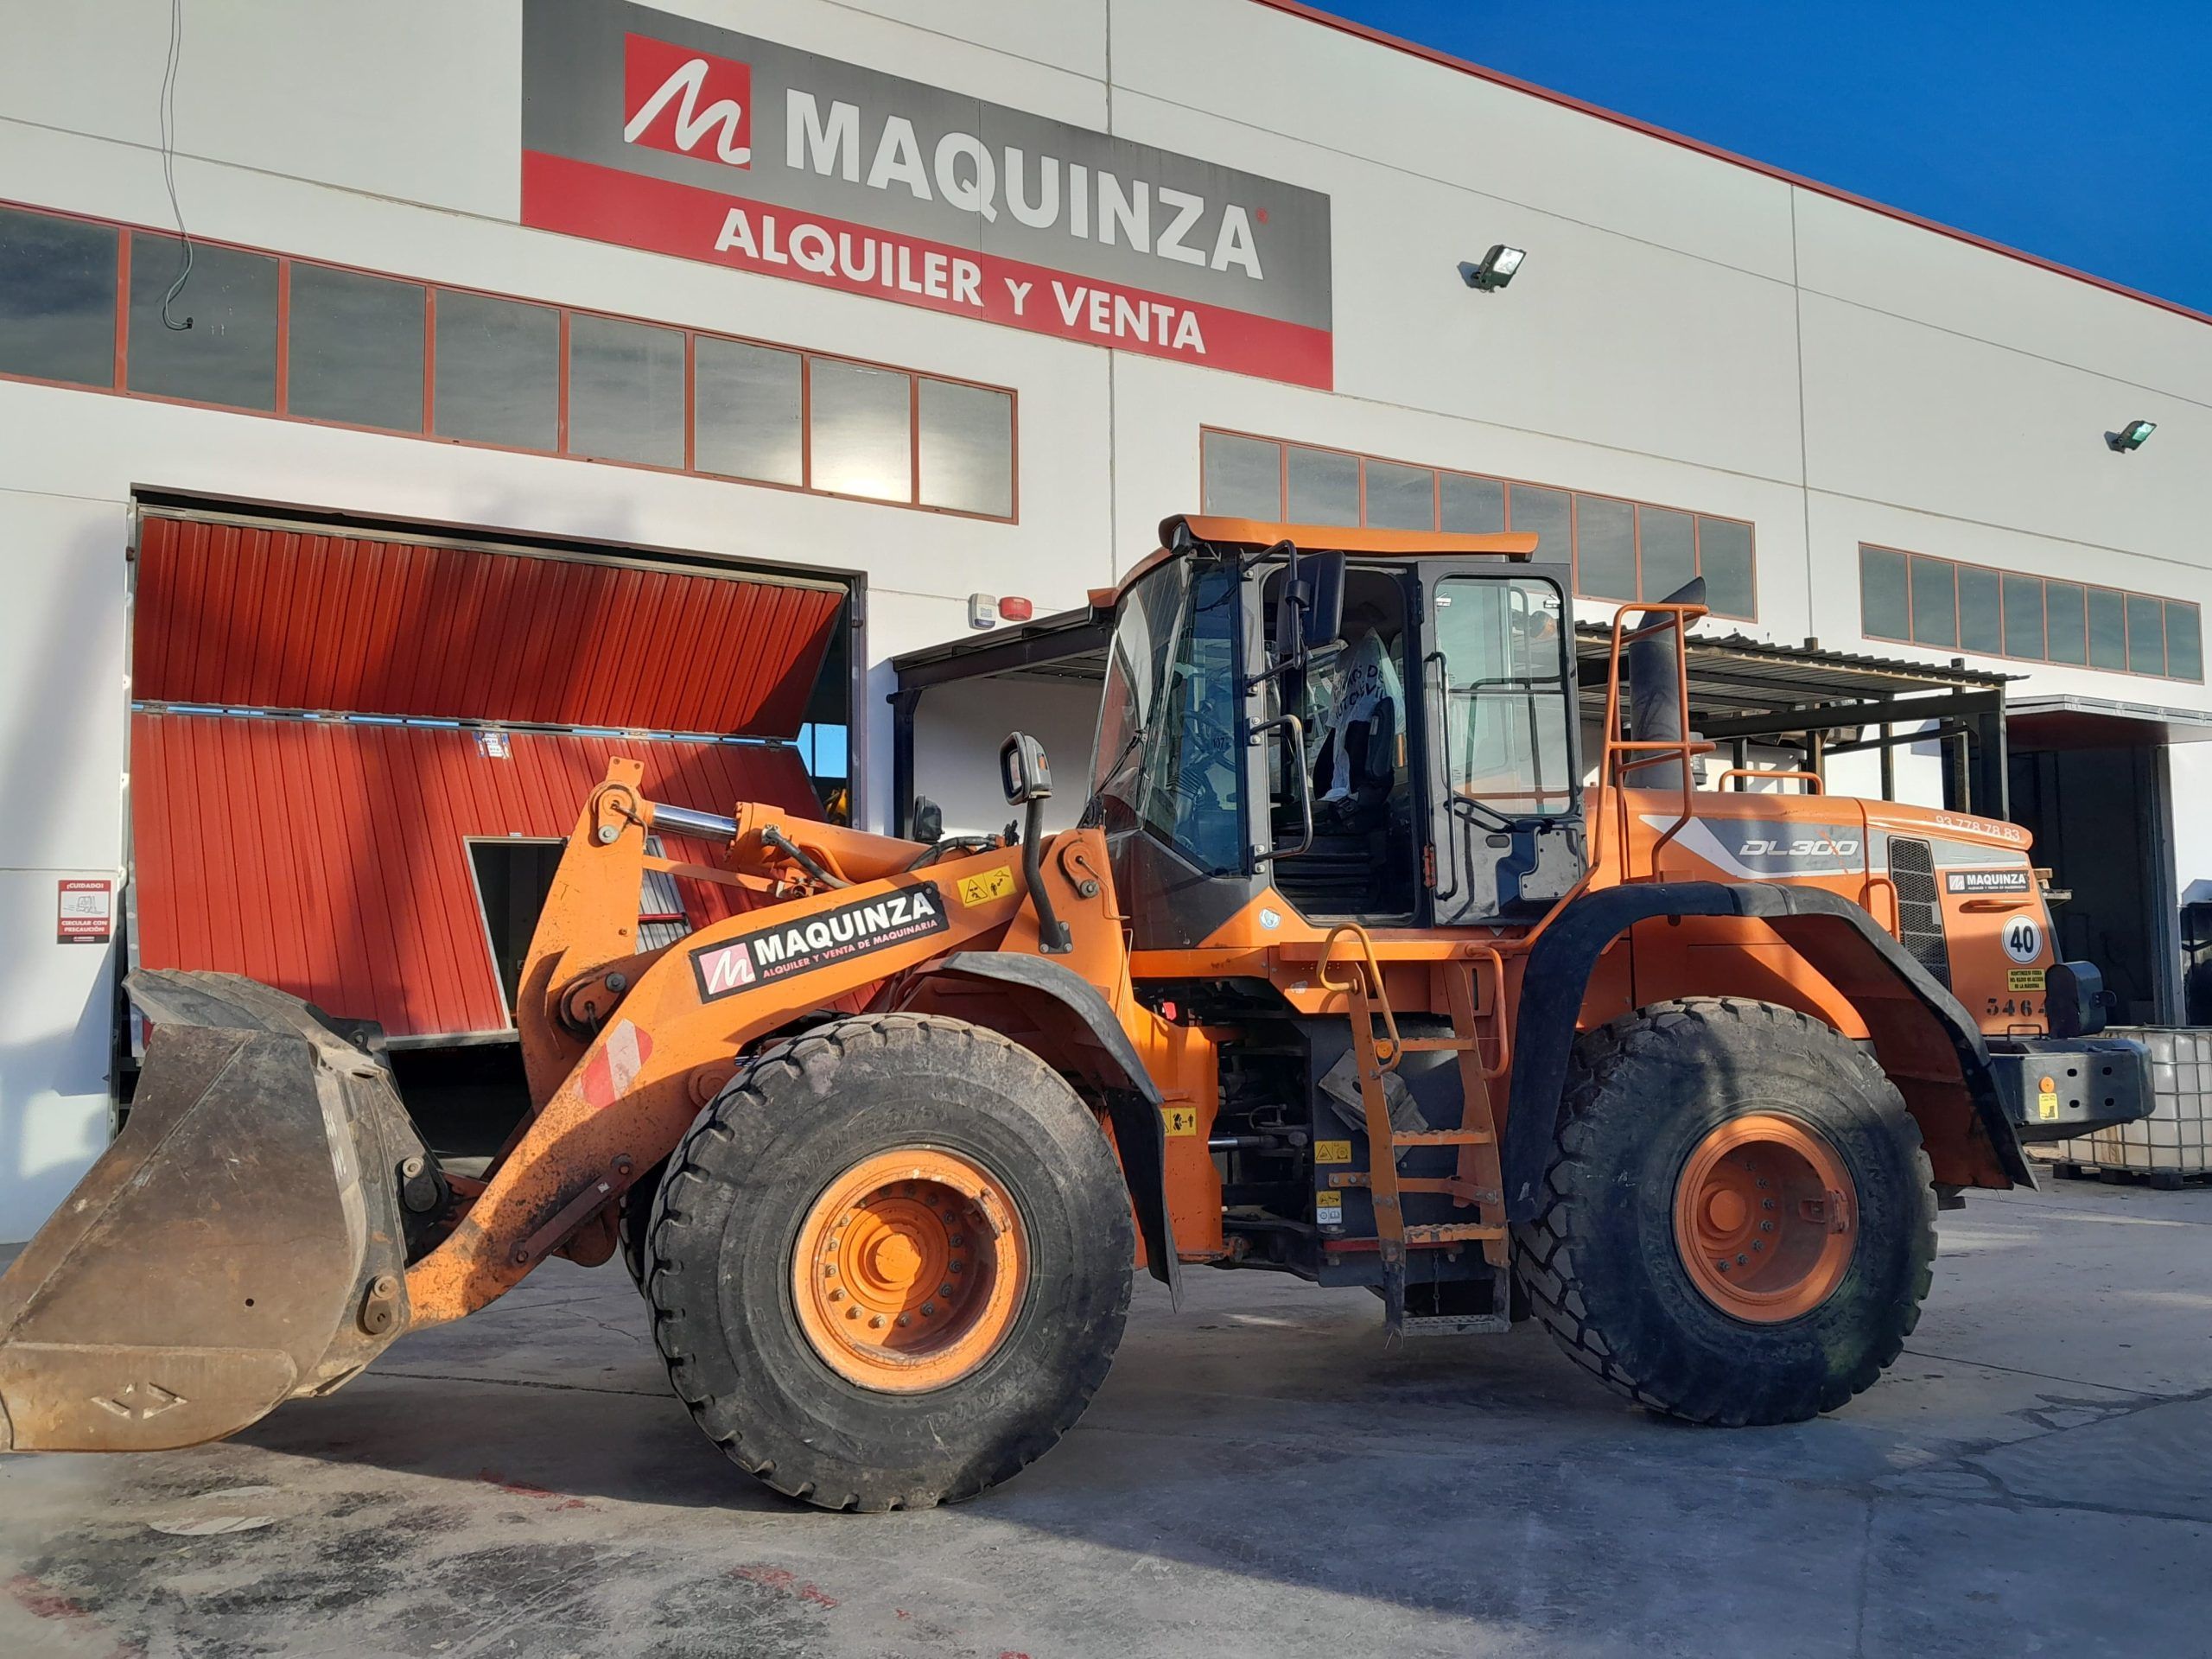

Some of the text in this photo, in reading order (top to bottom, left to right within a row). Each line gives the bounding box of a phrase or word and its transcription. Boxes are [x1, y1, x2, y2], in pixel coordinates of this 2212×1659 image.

[786, 87, 1263, 280] MAQUINZA
[714, 207, 1206, 354] ALQUILER Y VENTA
[1739, 840, 1859, 855] DL300
[1967, 874, 2026, 885] MAQUINZA
[753, 892, 936, 966] MAQUINZA
[763, 918, 938, 978] ALQUILER Y VENTA DE MAQUINARIA
[2011, 925, 2033, 953] 40
